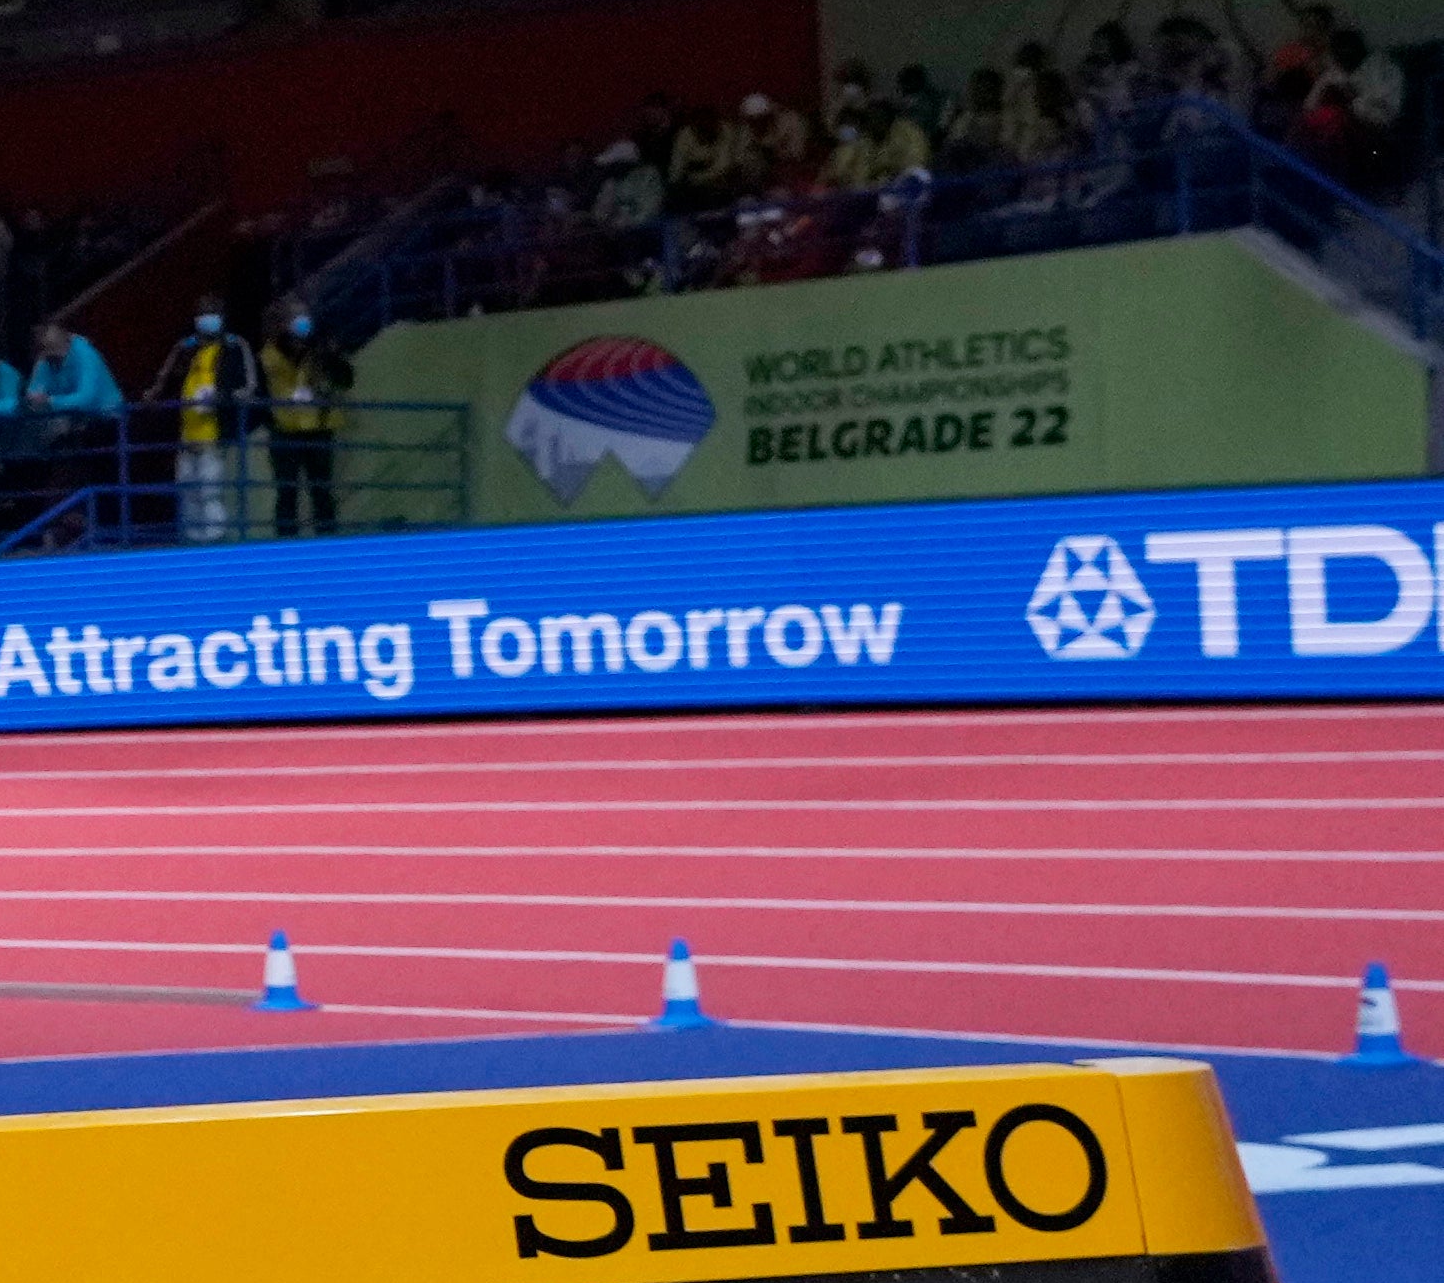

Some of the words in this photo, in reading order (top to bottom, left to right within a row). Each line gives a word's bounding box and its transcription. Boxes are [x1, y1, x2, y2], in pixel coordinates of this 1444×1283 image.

[745, 344, 867, 386] WORLD
[877, 325, 1069, 370] ATHLETICS
[747, 412, 993, 465] BELGRADE
[1010, 405, 1069, 448] 22
[1144, 521, 1444, 658] TD
[428, 598, 903, 679] Tomorrow
[504, 1102, 1108, 1261] SEIKO
